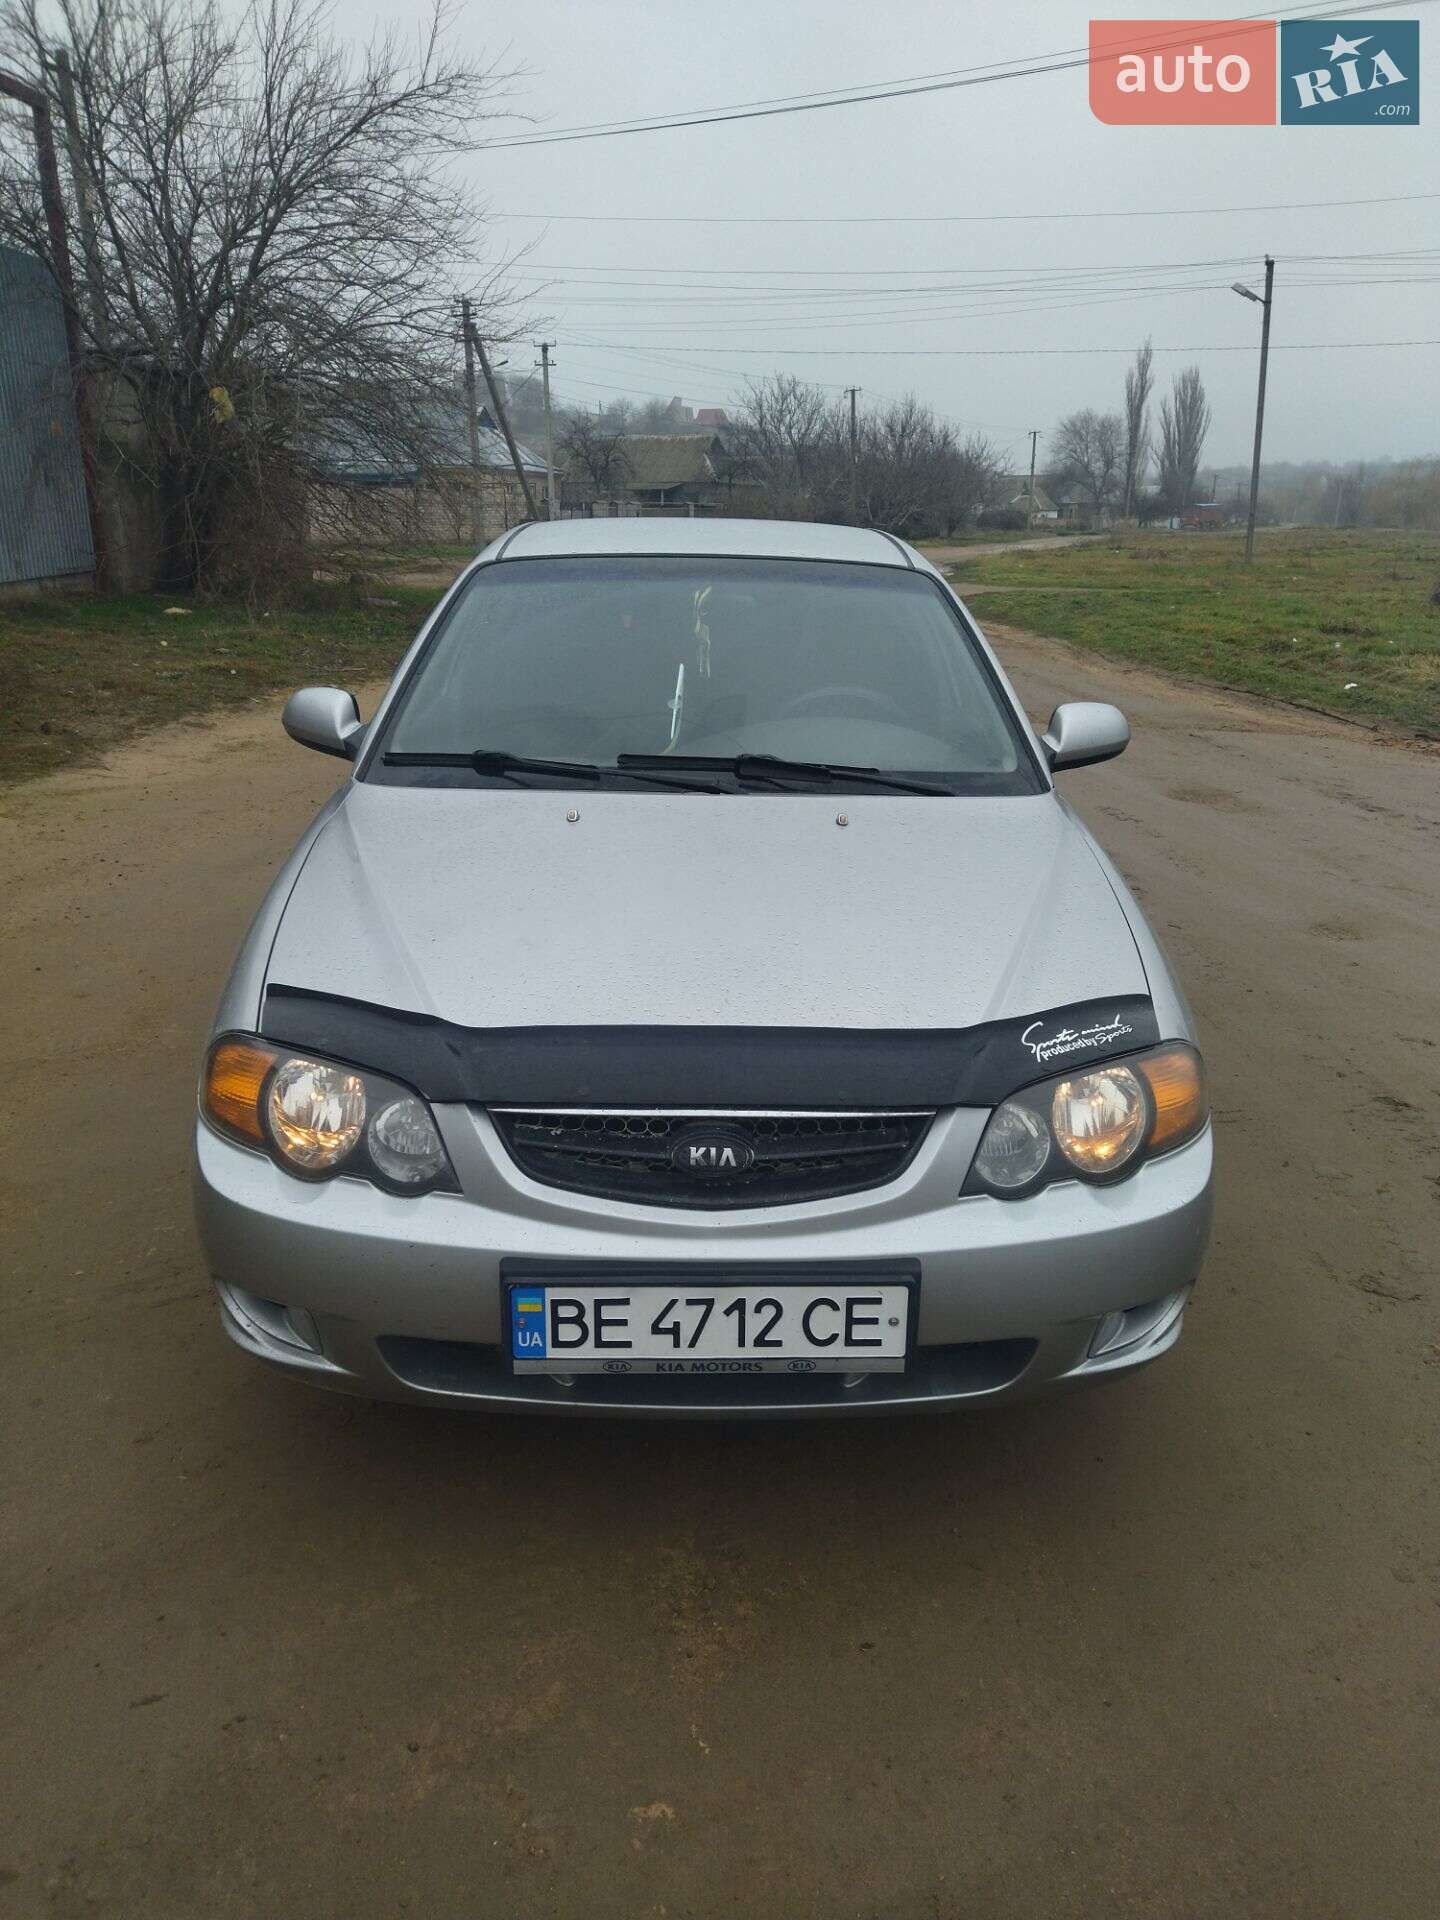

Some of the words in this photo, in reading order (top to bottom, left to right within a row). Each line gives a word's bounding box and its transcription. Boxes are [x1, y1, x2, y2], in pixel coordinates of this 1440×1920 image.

[1095, 1024, 1132, 1044] Sports
[688, 1146, 738, 1167] KIA
[549, 1297, 633, 1349] BE
[650, 1297, 784, 1349] 4712
[801, 1297, 883, 1347] CE
[517, 1332, 543, 1348] UA
[655, 1361, 686, 1372] KIA
[690, 1361, 764, 1372] MOTORS
